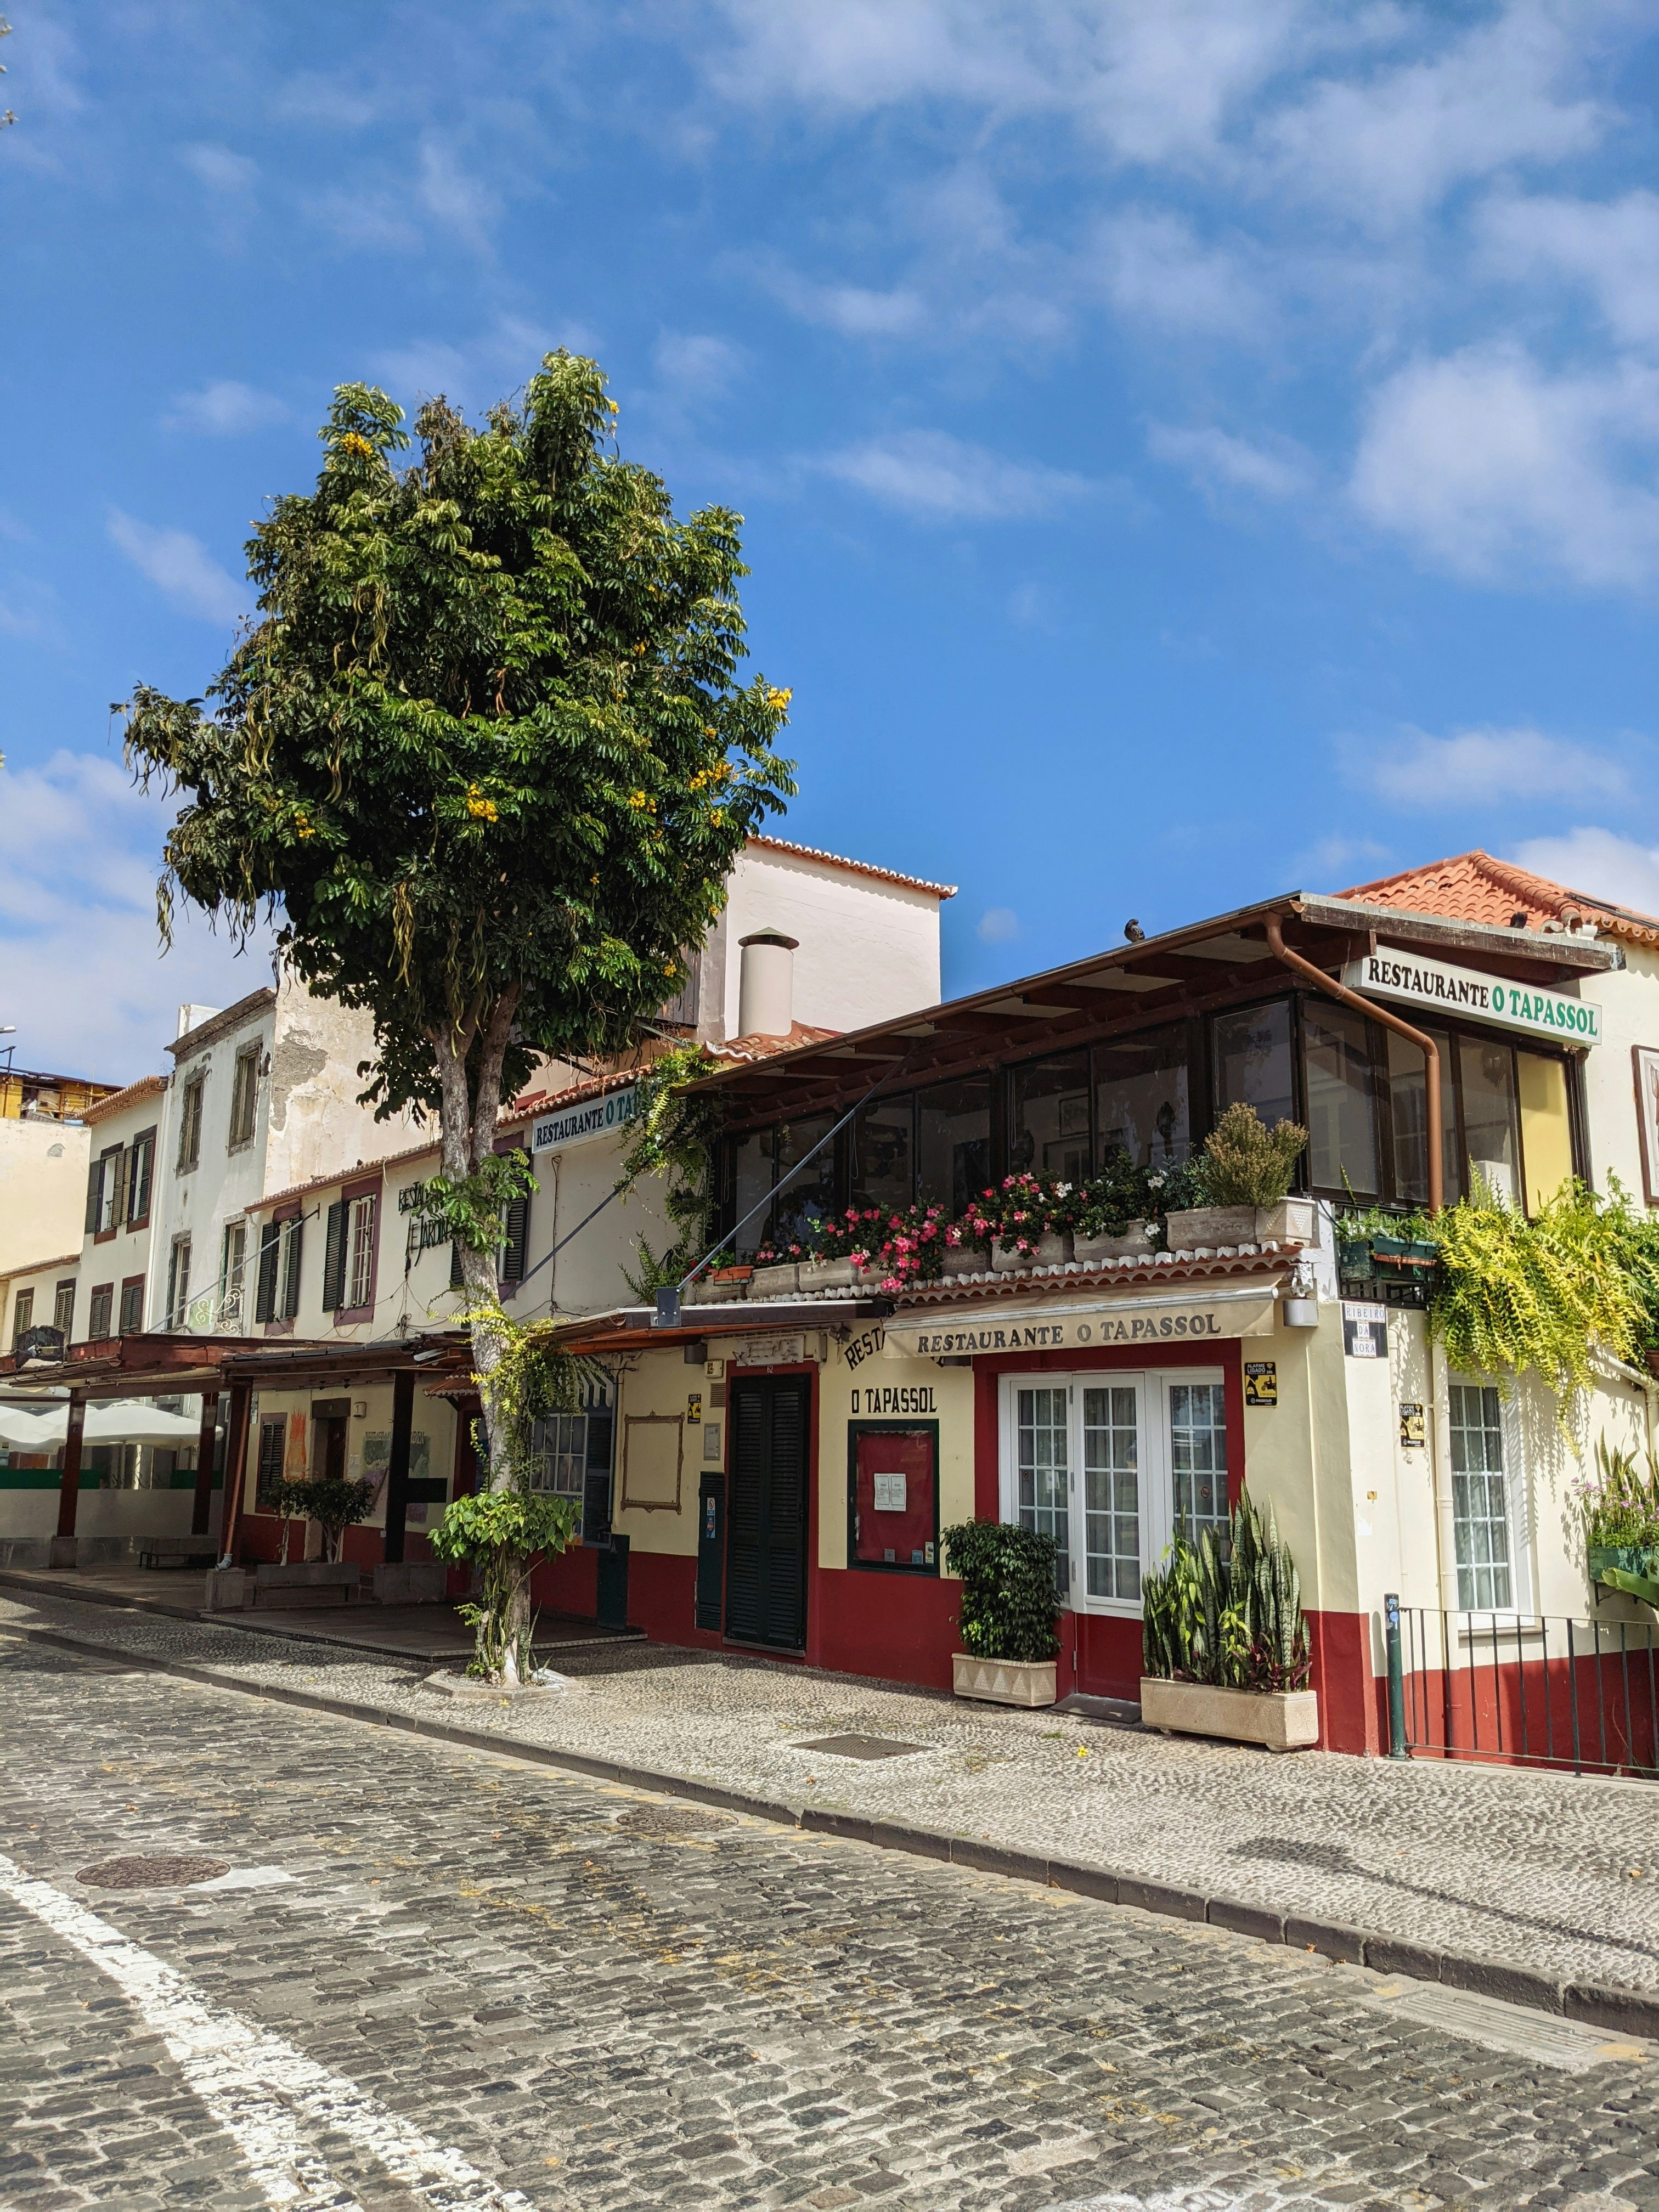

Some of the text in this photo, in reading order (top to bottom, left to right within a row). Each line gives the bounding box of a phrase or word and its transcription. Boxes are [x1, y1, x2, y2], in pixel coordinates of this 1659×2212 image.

[1368, 958, 1598, 1036] RESTAURANTE O TAPASSOL
[536, 1107, 603, 1147] RESTAURANTE
[606, 1100, 614, 1125] O
[1346, 1307, 1384, 1318] RIBEIRO
[918, 1314, 1221, 1353] RESTAURANTE O TAPASSOL
[1359, 1326, 1369, 1335] DA
[1354, 1344, 1375, 1353] NORA
[851, 1387, 938, 1414] O TAPASSOL
